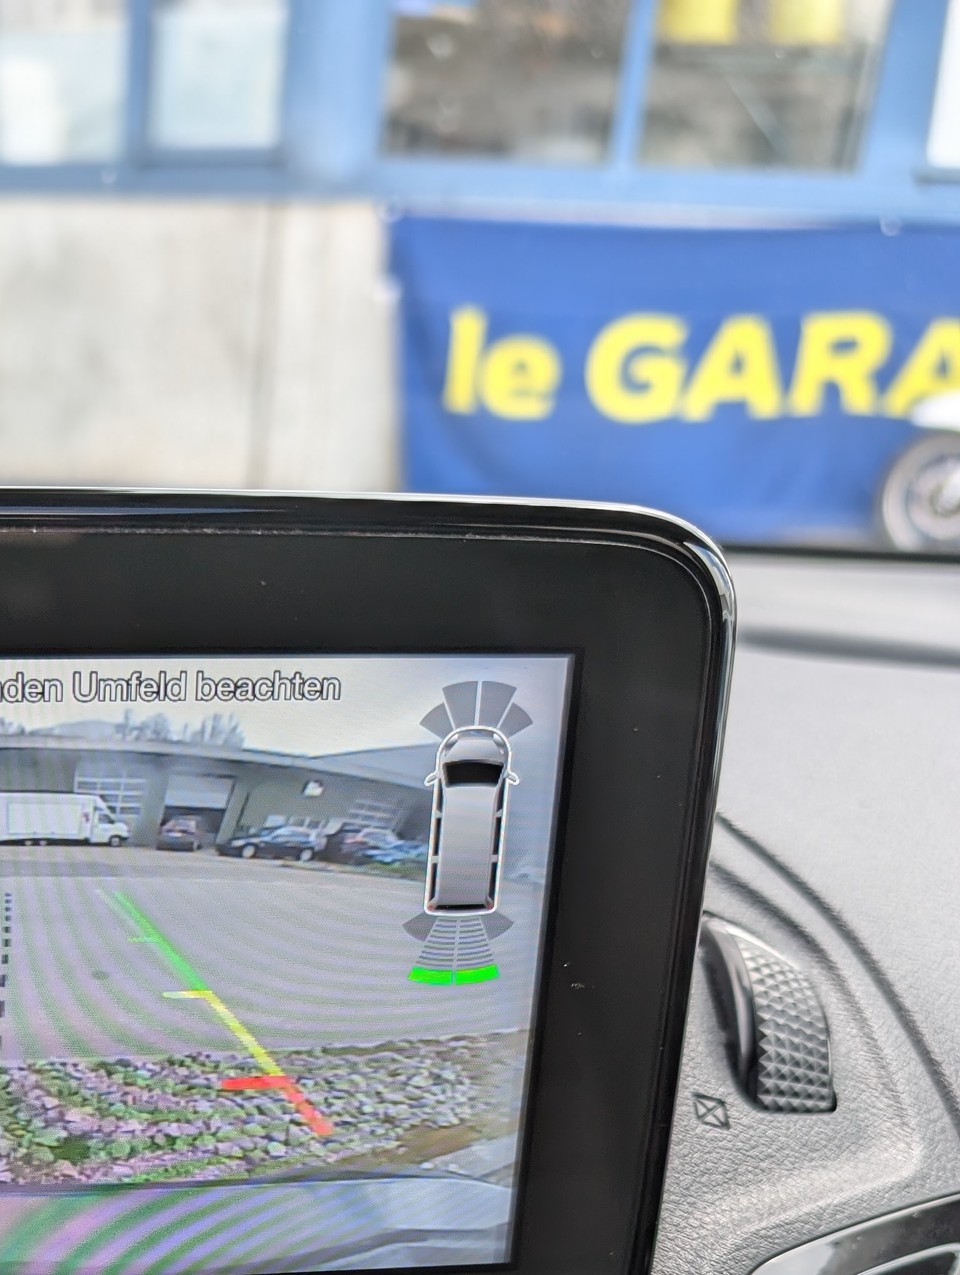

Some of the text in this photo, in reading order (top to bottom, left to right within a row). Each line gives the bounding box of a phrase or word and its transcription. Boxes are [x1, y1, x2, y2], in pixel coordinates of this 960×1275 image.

[444, 306, 560, 420] le
[72, 670, 187, 702] Umfeld
[195, 670, 341, 702] beachten
